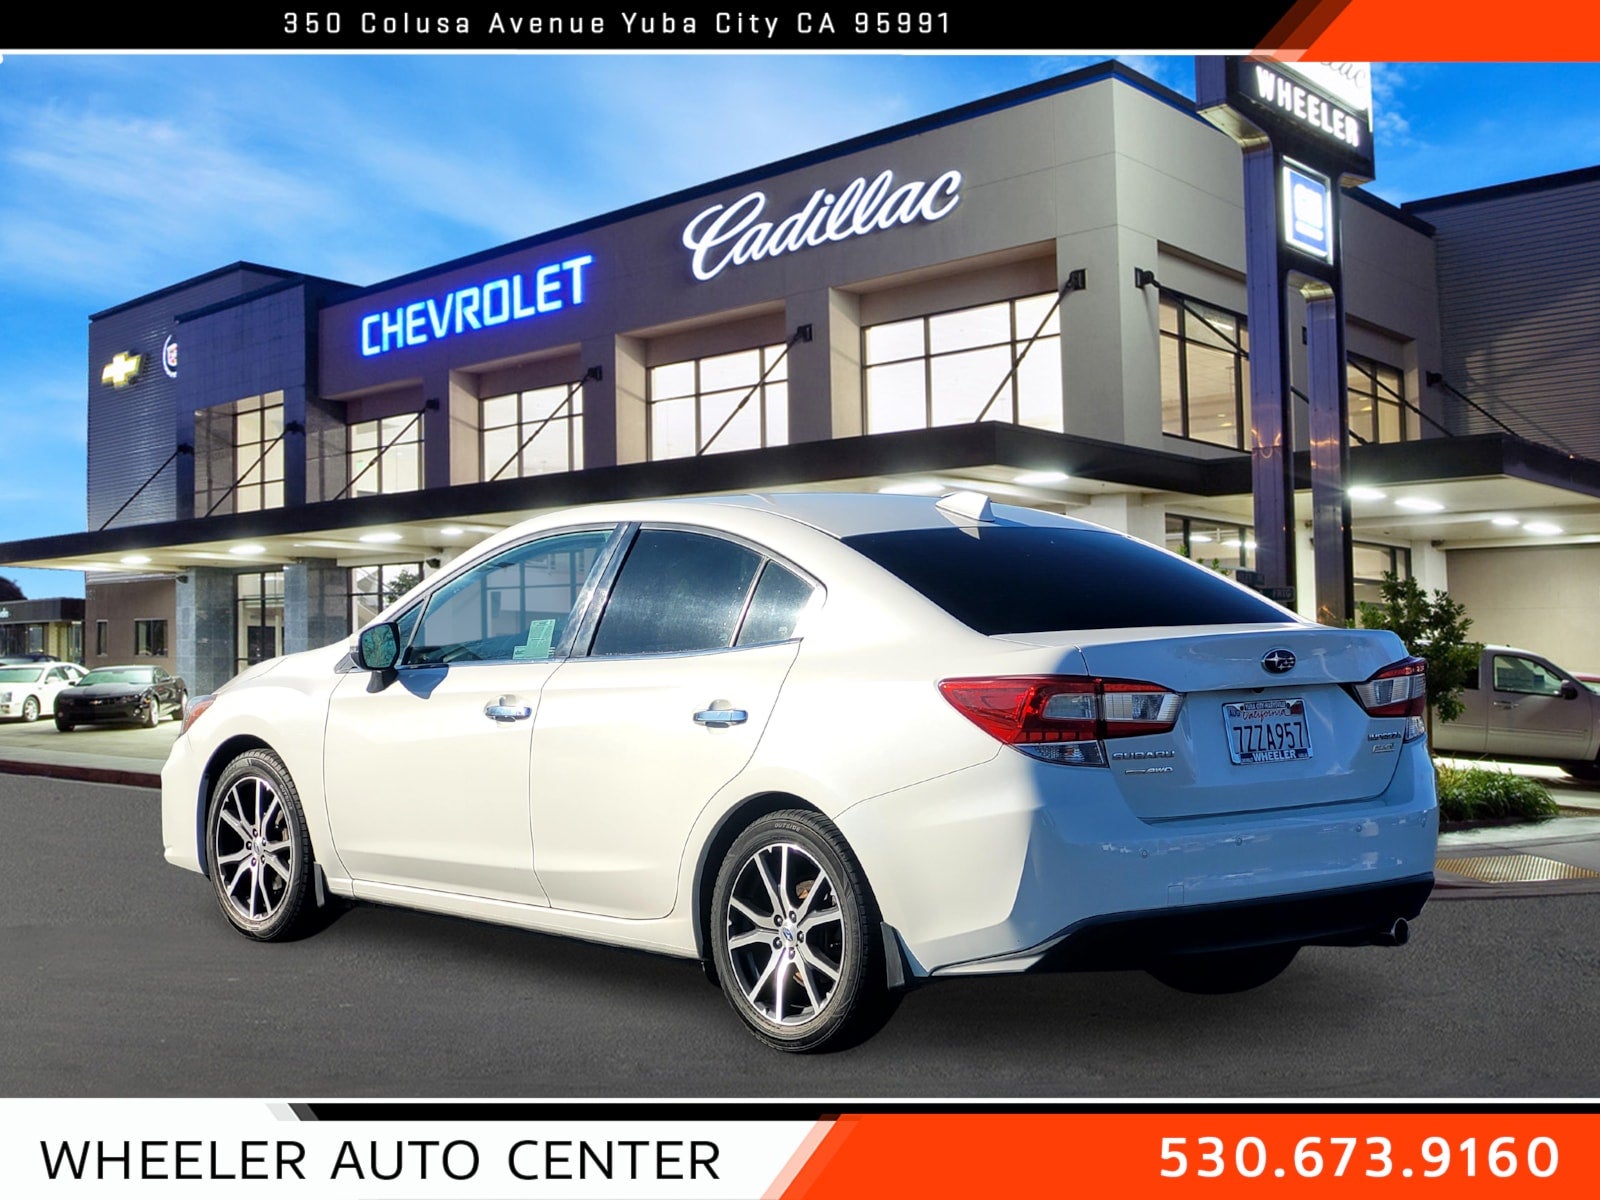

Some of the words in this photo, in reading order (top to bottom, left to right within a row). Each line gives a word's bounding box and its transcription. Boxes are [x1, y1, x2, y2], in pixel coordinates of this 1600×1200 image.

[1255, 64, 1360, 148] WHEELER
[682, 169, 963, 281] Cadillac
[361, 254, 593, 357] CHEVROLET
[1113, 751, 1175, 760] SUBARU
[1233, 722, 1304, 753] 7ZZA957
[1253, 749, 1297, 763] WHEELER
